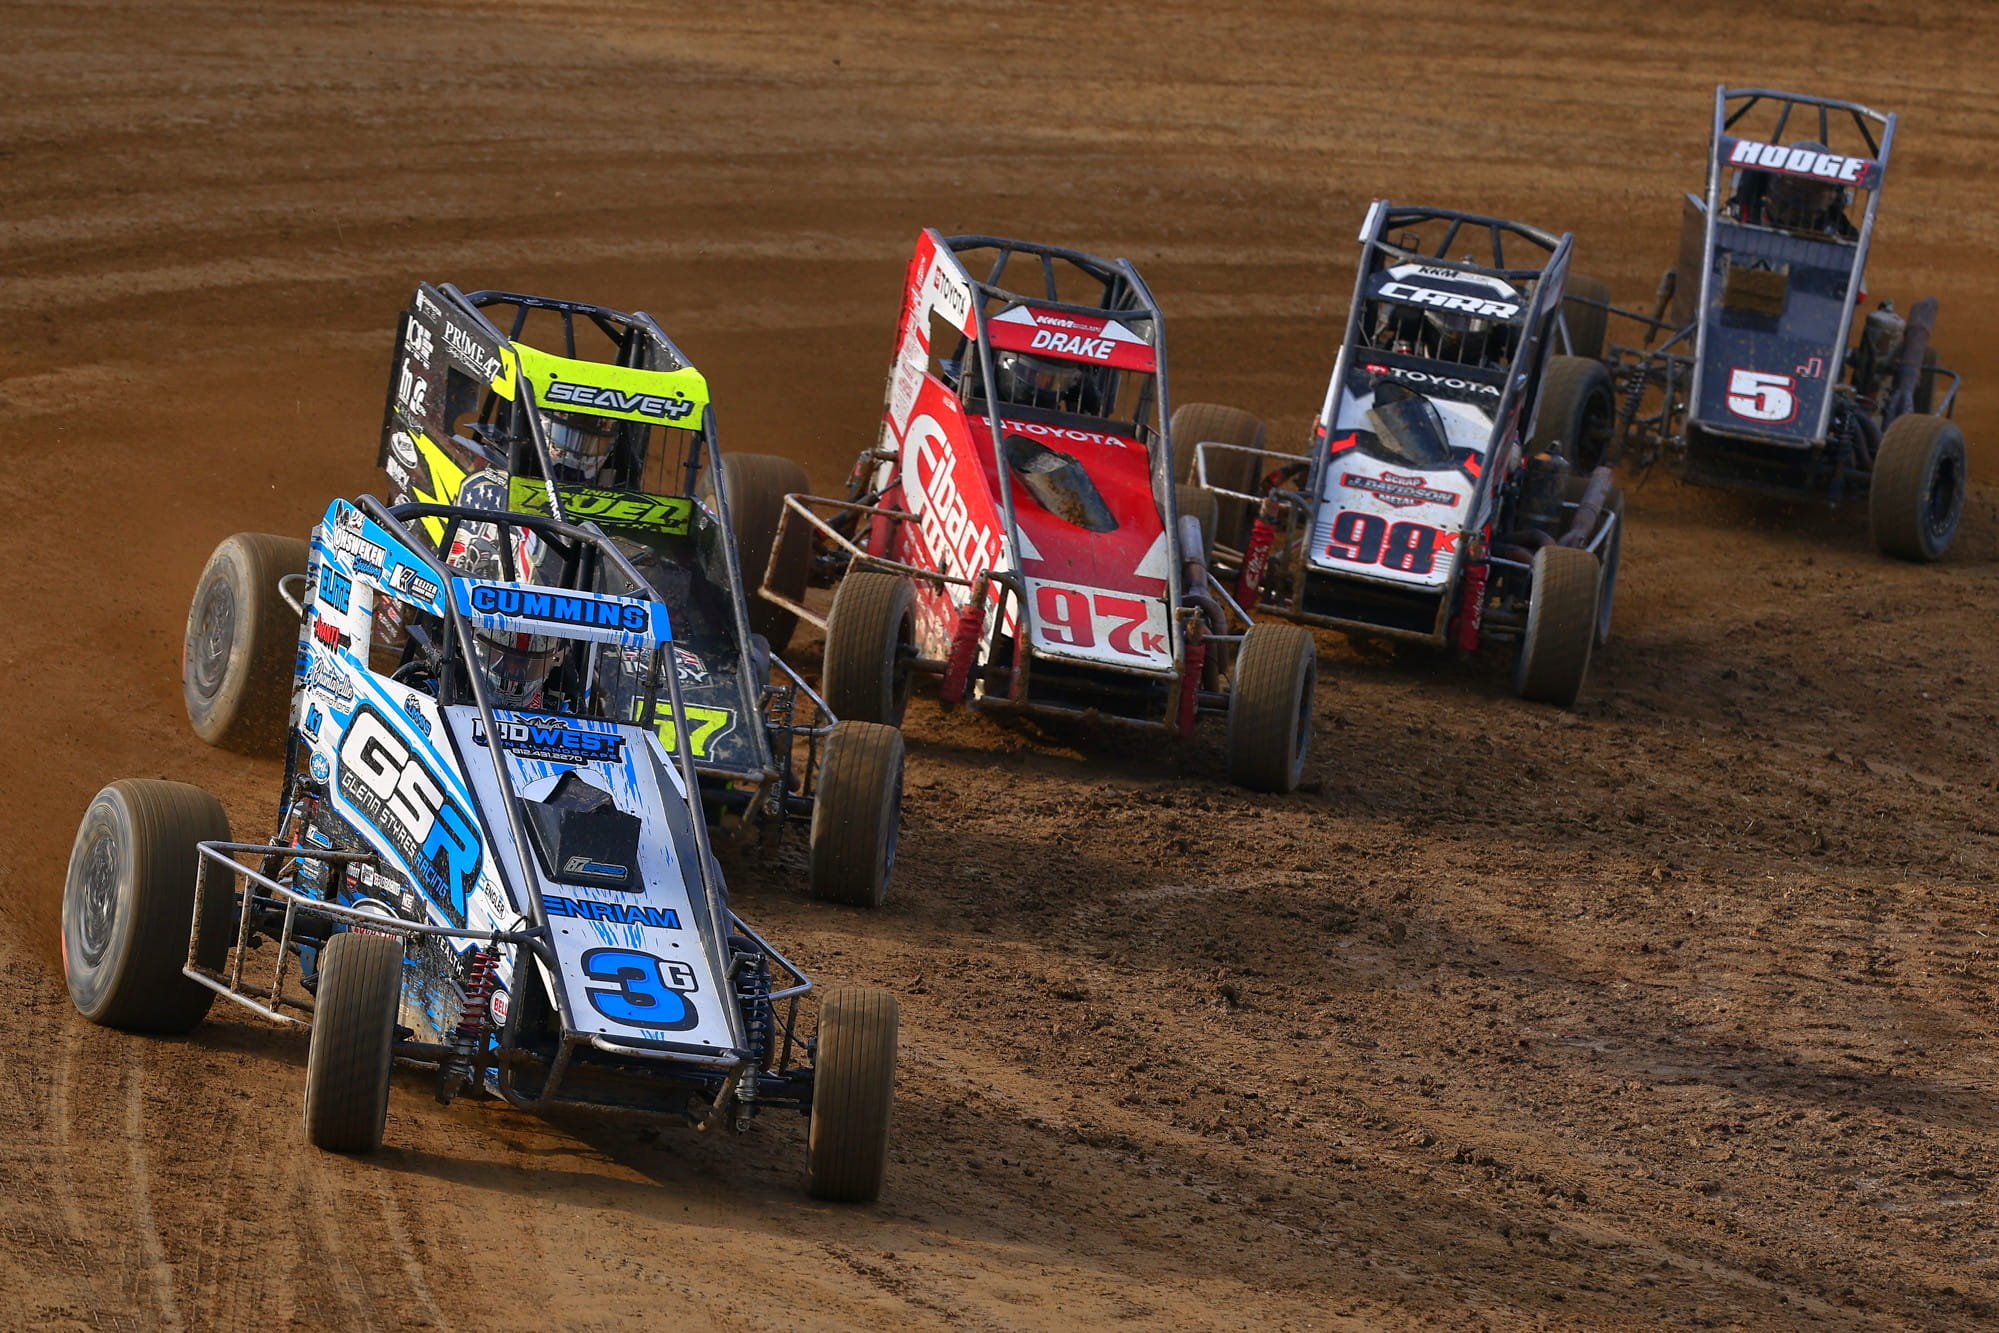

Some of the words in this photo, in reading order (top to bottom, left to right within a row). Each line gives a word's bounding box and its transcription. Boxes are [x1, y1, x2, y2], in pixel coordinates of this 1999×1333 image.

[1731, 140, 1867, 181] HODGE
[942, 273, 966, 321] TOYOTA
[1379, 282, 1520, 319] CARR
[444, 321, 485, 366] PRIME
[482, 357, 501, 381] 47
[1031, 329, 1116, 360] DRAKE
[546, 383, 693, 418] SEAVEY
[1390, 367, 1500, 396] TOYOTA
[1726, 368, 1799, 423] 5
[1008, 420, 1128, 448] TOYOTA
[582, 488, 625, 499] INDY
[1384, 472, 1421, 486] SCRAP
[335, 527, 386, 568] OHSWEKEN
[319, 565, 352, 615] ELITE
[413, 576, 438, 595] KEIZER
[473, 587, 648, 631] CUMMINS
[341, 711, 480, 917] GSR
[341, 773, 381, 814] GLENN
[380, 809, 417, 858] STYRES
[416, 852, 449, 896] RACING
[484, 883, 505, 917] ENGLER
